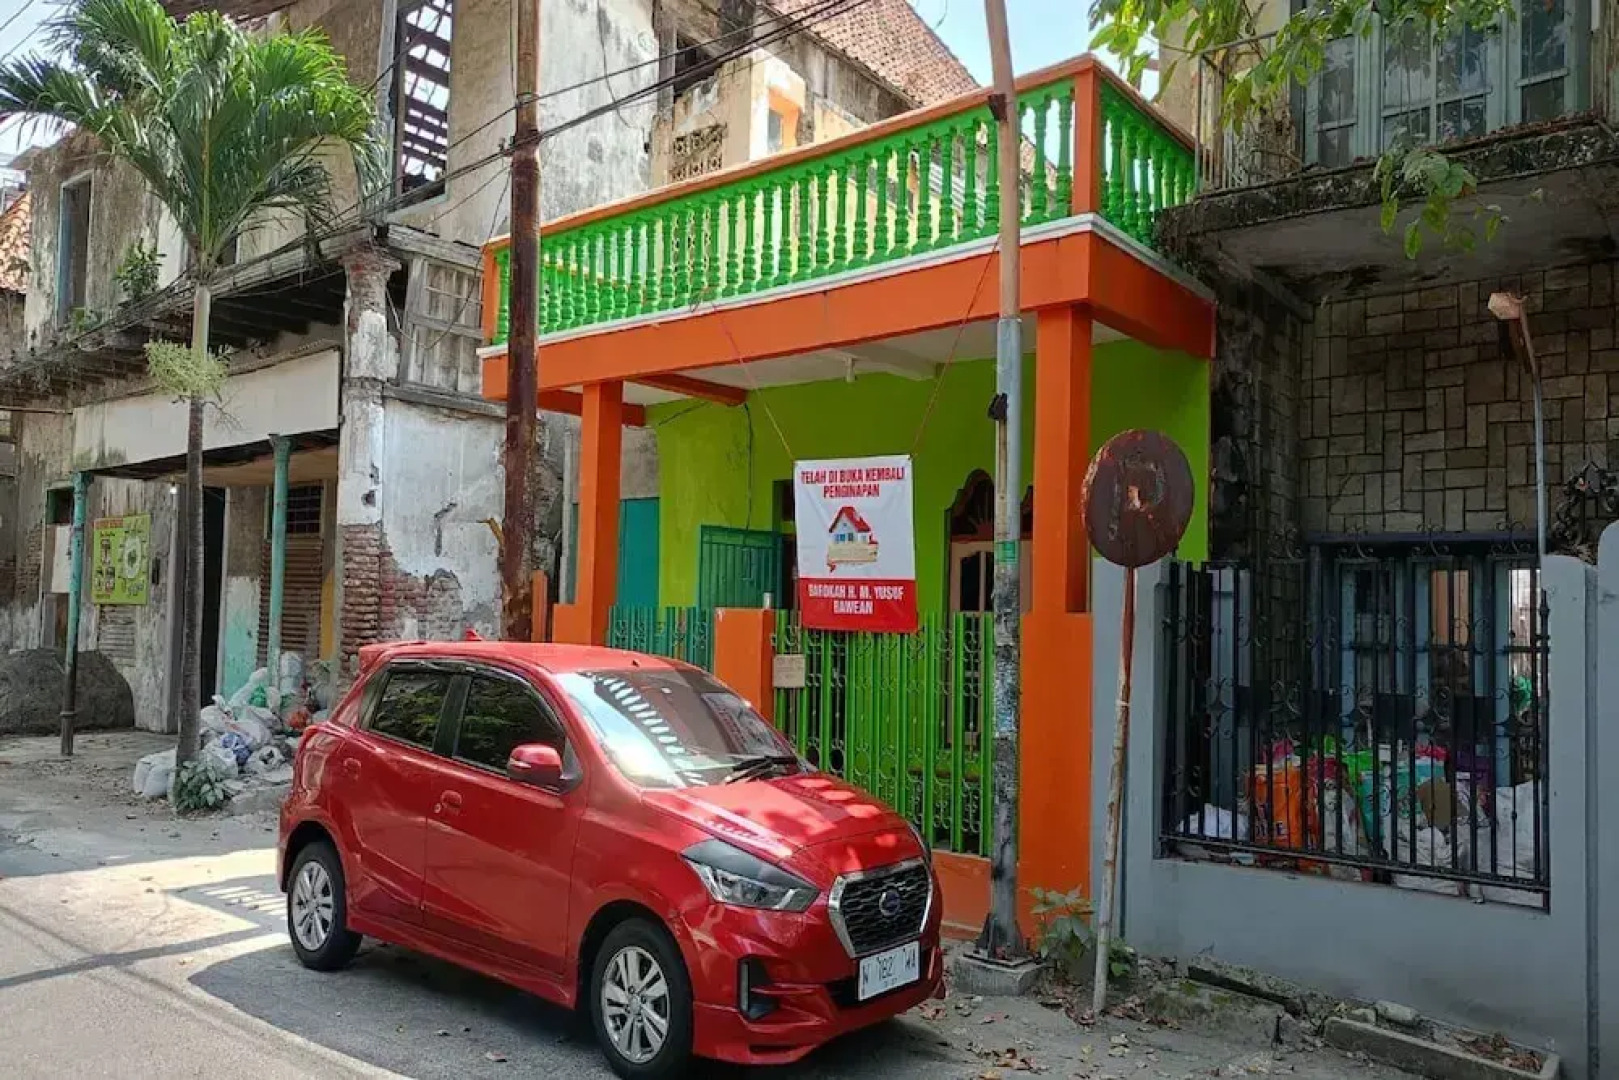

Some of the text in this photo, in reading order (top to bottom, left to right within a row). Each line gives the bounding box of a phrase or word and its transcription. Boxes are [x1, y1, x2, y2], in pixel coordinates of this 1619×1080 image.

[801, 467, 905, 484] TELAH DI BUKA KEMBALI
[824, 484, 880, 498] PENGINAPAN
[874, 586, 904, 600] YUSUF
